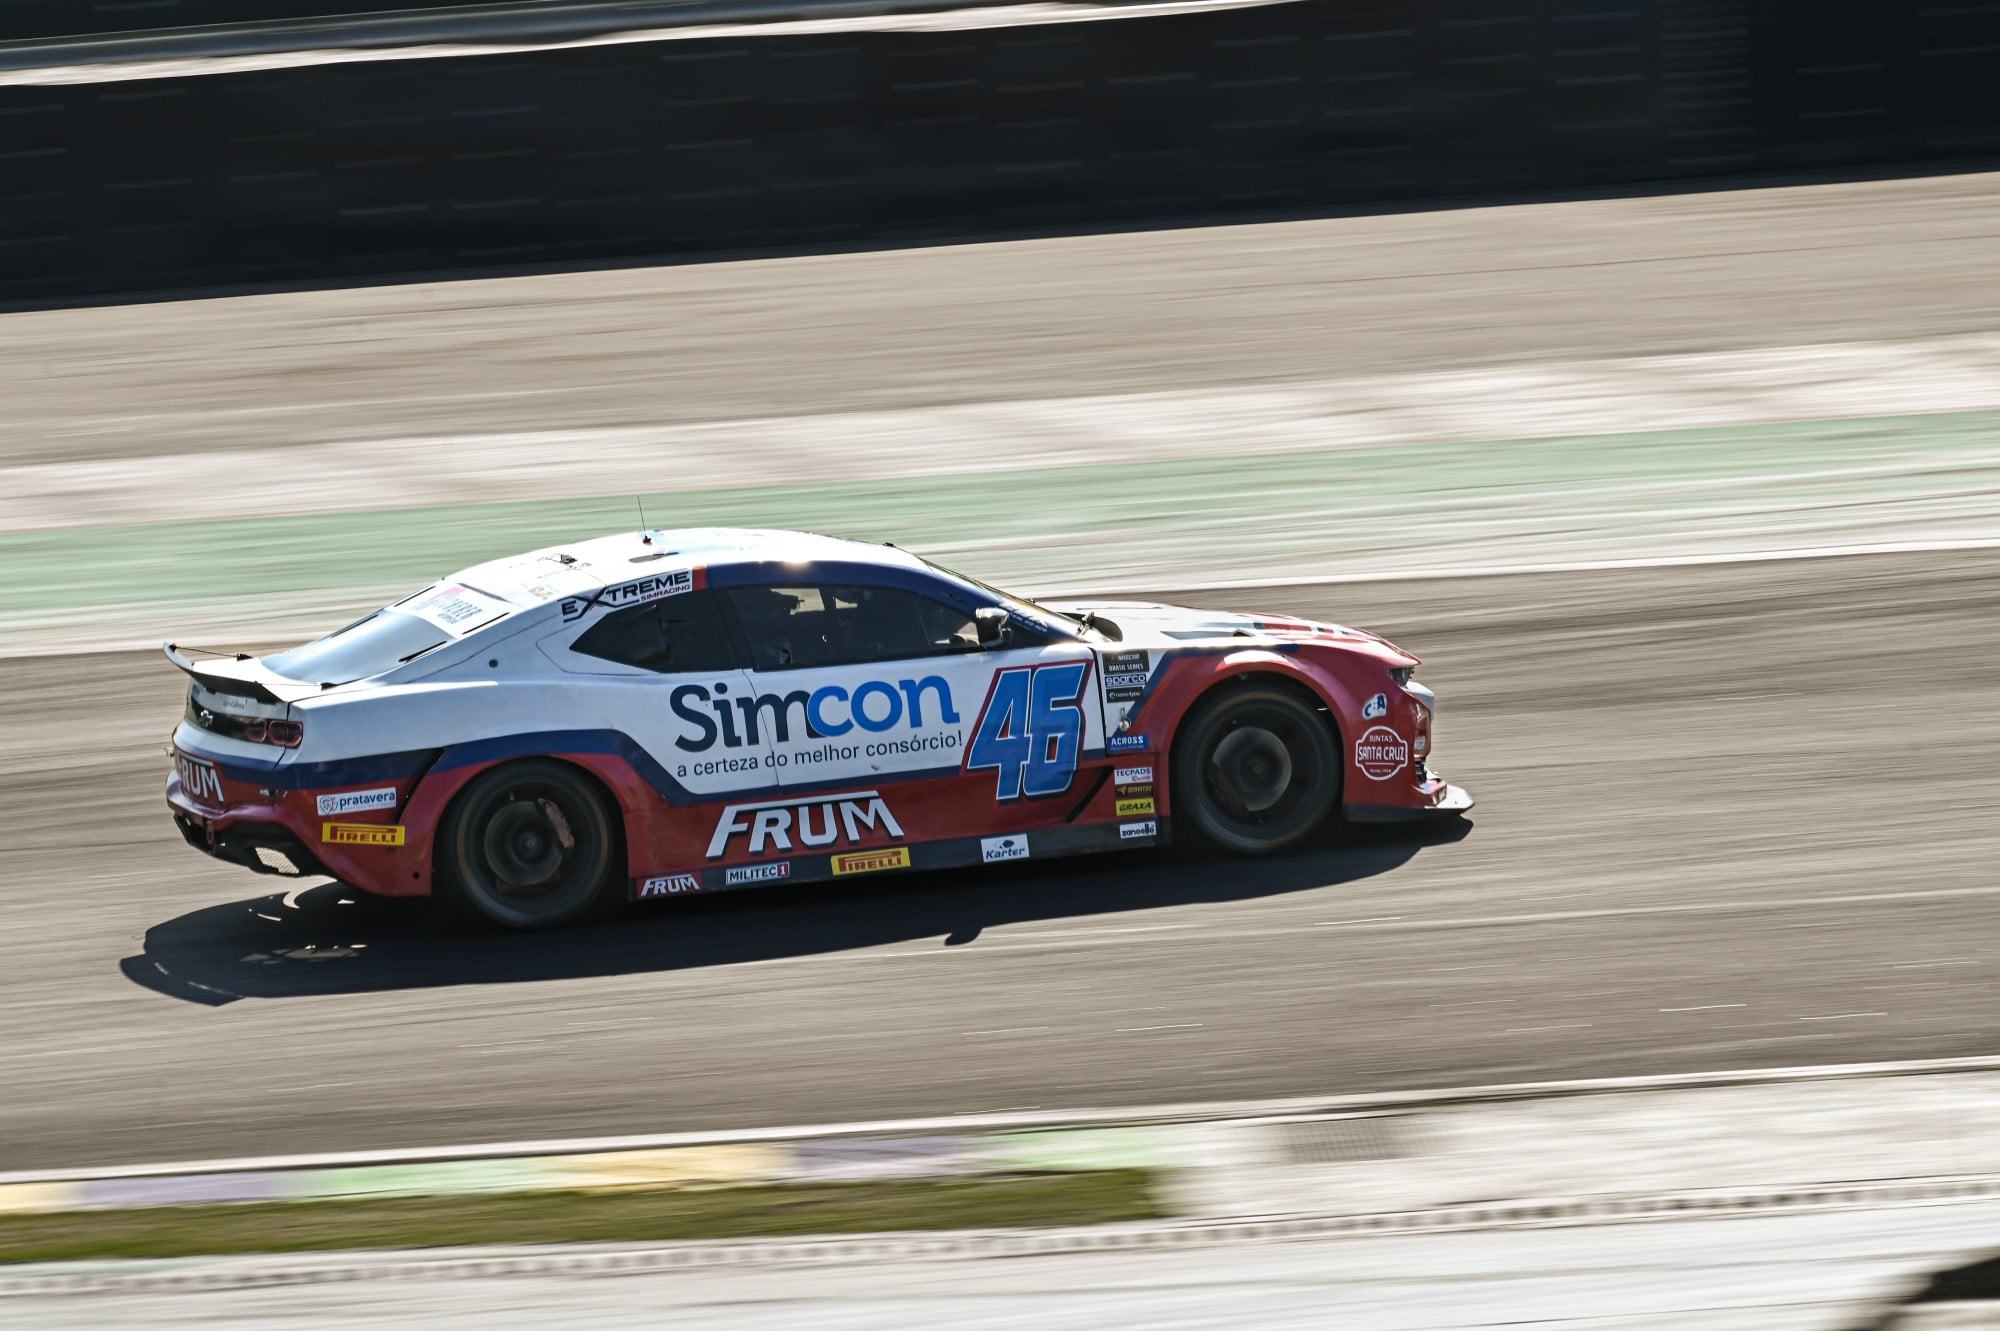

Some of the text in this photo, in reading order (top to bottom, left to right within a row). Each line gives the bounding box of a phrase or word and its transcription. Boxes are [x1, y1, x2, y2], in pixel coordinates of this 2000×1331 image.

[558, 571, 690, 621] EXTREME
[640, 584, 691, 602] SIMRACING
[1105, 674, 1146, 686] sparco
[670, 675, 961, 753] Simcon
[966, 663, 1087, 800] 46
[1111, 735, 1145, 746] ACROSS
[1369, 735, 1393, 743] JUNTAS
[677, 729, 963, 778] a certeza do melhor consórcio!
[1358, 746, 1405, 761] SANTA CRUZ
[1116, 767, 1151, 777] TECPADS
[340, 792, 395, 811] pratavera
[1119, 803, 1152, 812] GRAXA
[705, 790, 905, 858] FRUM
[330, 825, 398, 844] PIRELLI
[838, 851, 902, 873] PIRELLI
[985, 847, 1025, 860] Karter
[640, 874, 700, 897] FRUM
